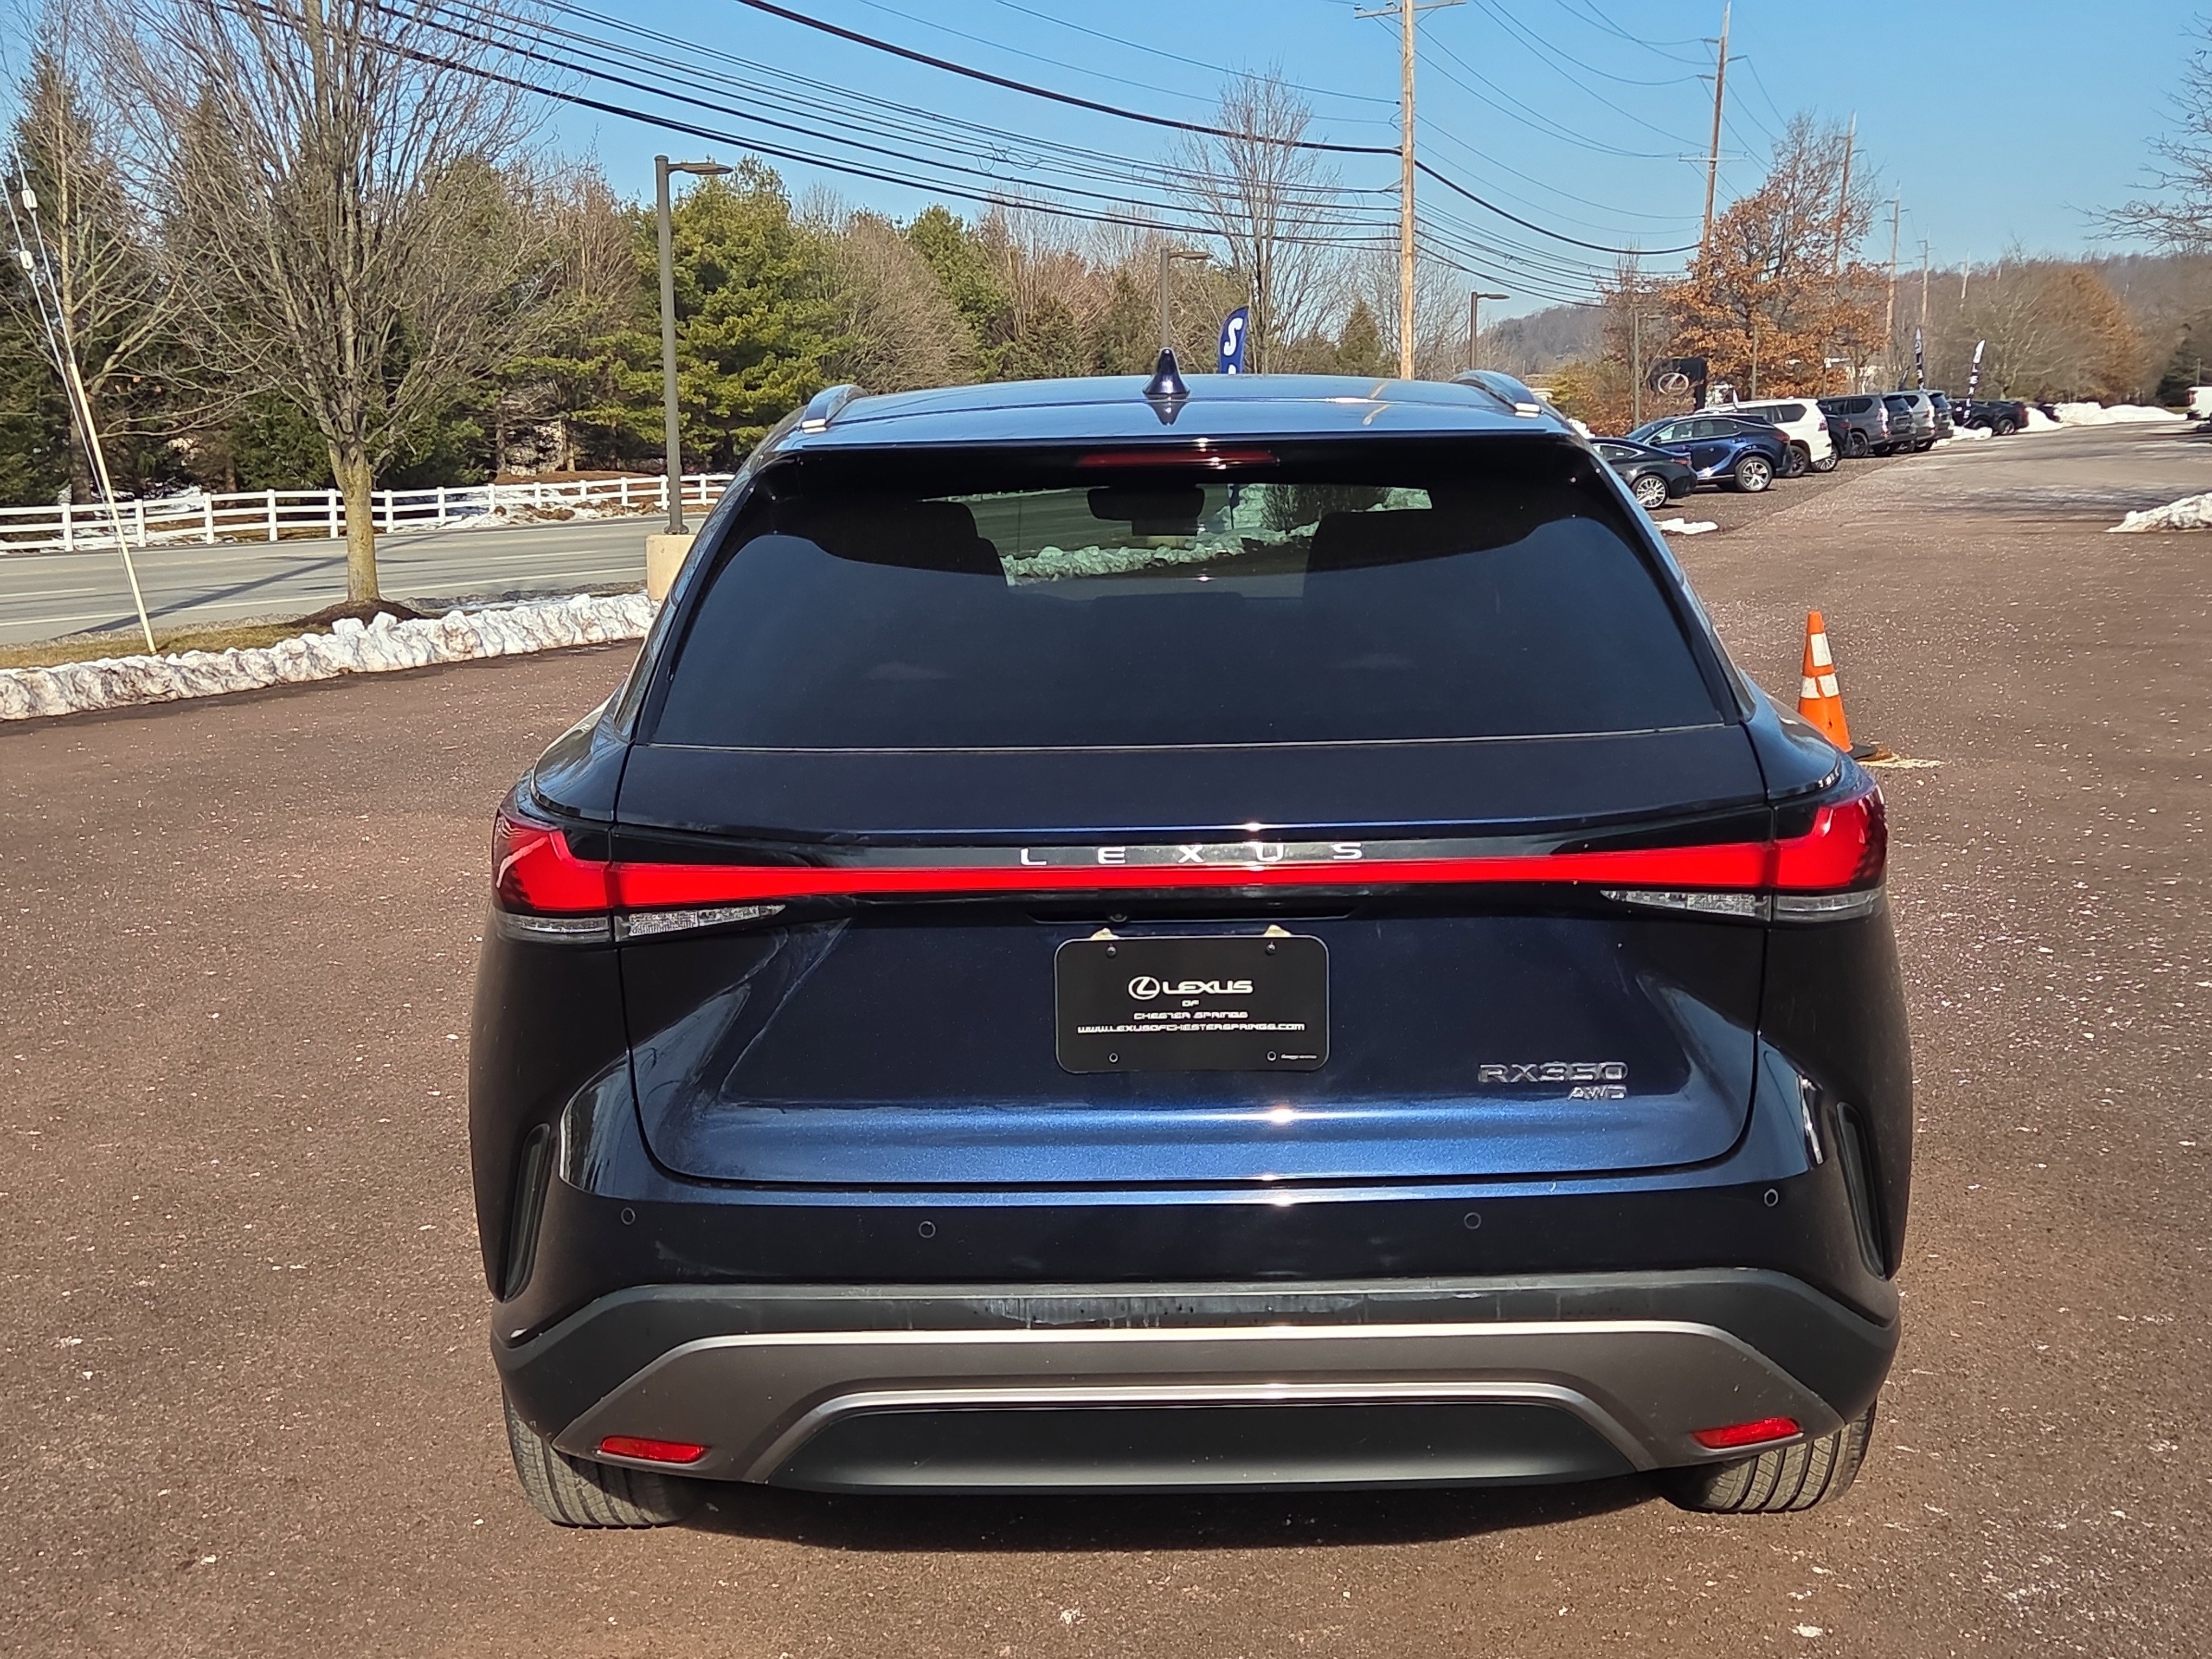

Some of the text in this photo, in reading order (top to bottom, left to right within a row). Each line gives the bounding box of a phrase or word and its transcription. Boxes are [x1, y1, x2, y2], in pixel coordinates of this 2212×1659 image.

[1020, 841, 1363, 866] LEXUS
[1162, 980, 1253, 994] LEXUS
[1134, 1011, 1249, 1020] CHESTER SPRINGS
[1477, 1061, 1628, 1083] RX350
[1567, 1084, 1627, 1100] AWD
